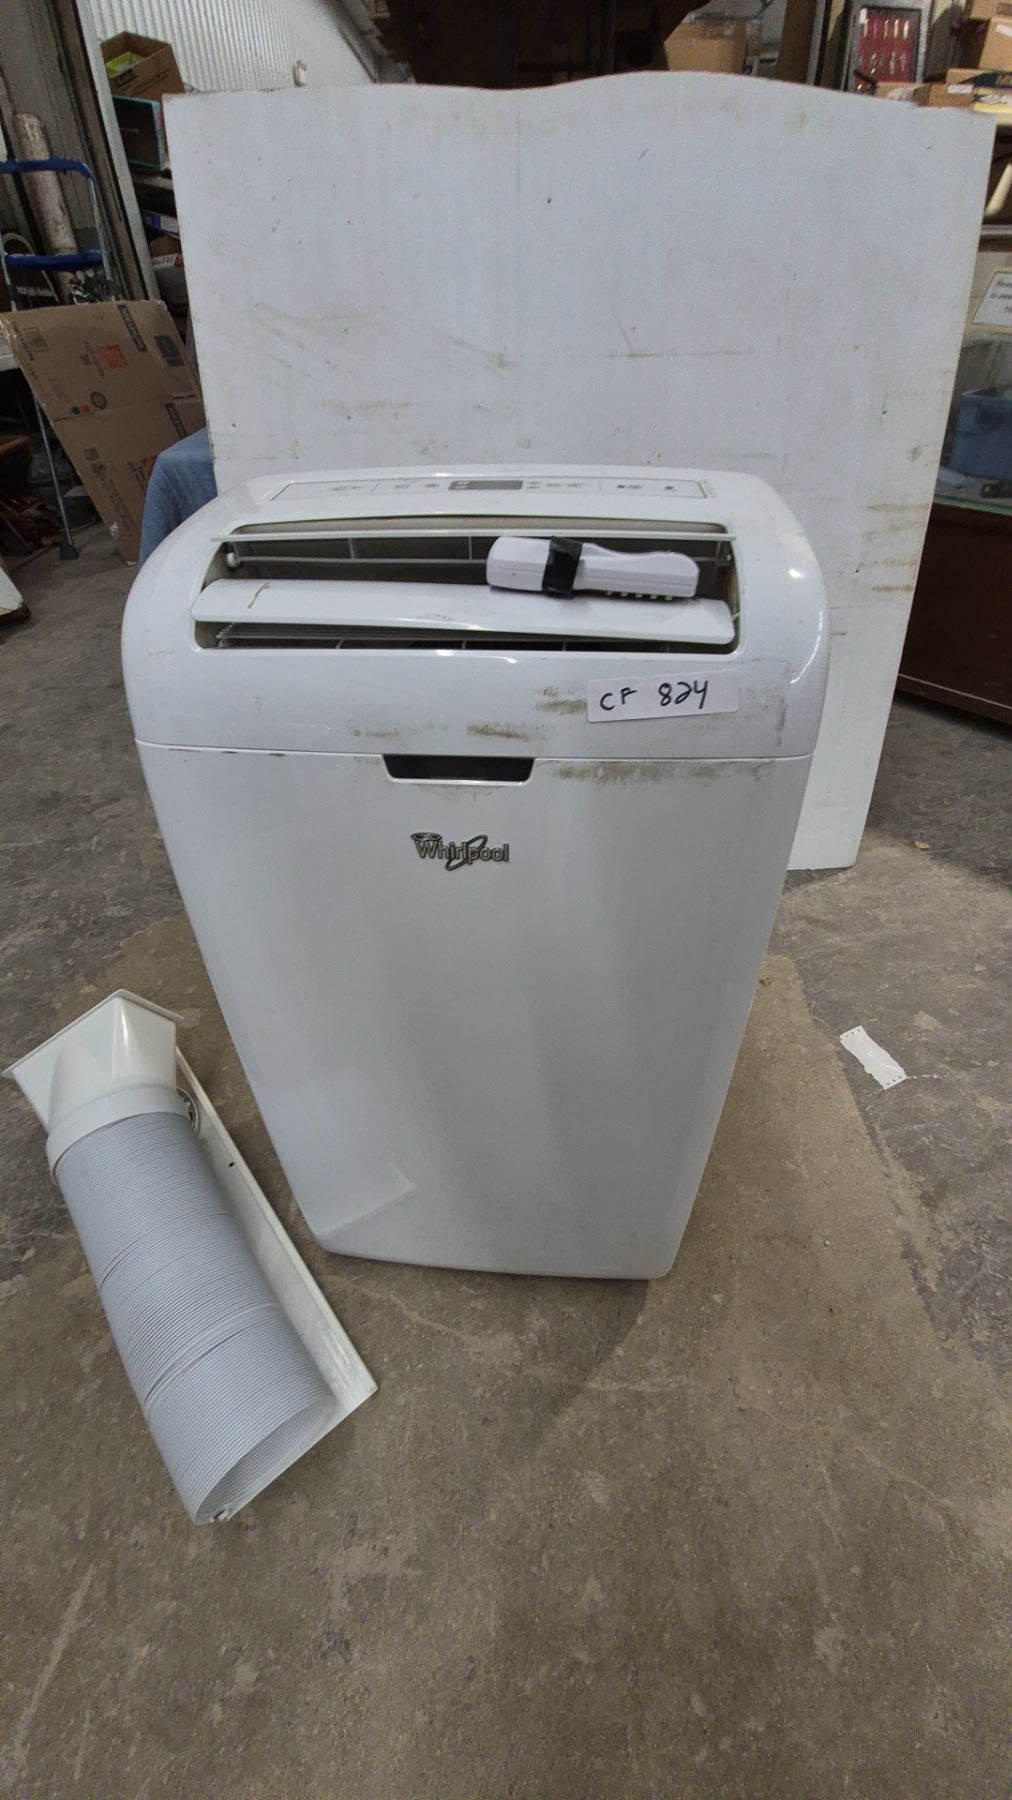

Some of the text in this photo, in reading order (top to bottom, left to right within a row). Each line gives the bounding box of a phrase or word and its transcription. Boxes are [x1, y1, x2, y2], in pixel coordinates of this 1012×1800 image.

[599, 680, 709, 711] CF 824
[410, 832, 510, 871] Whirlpool
